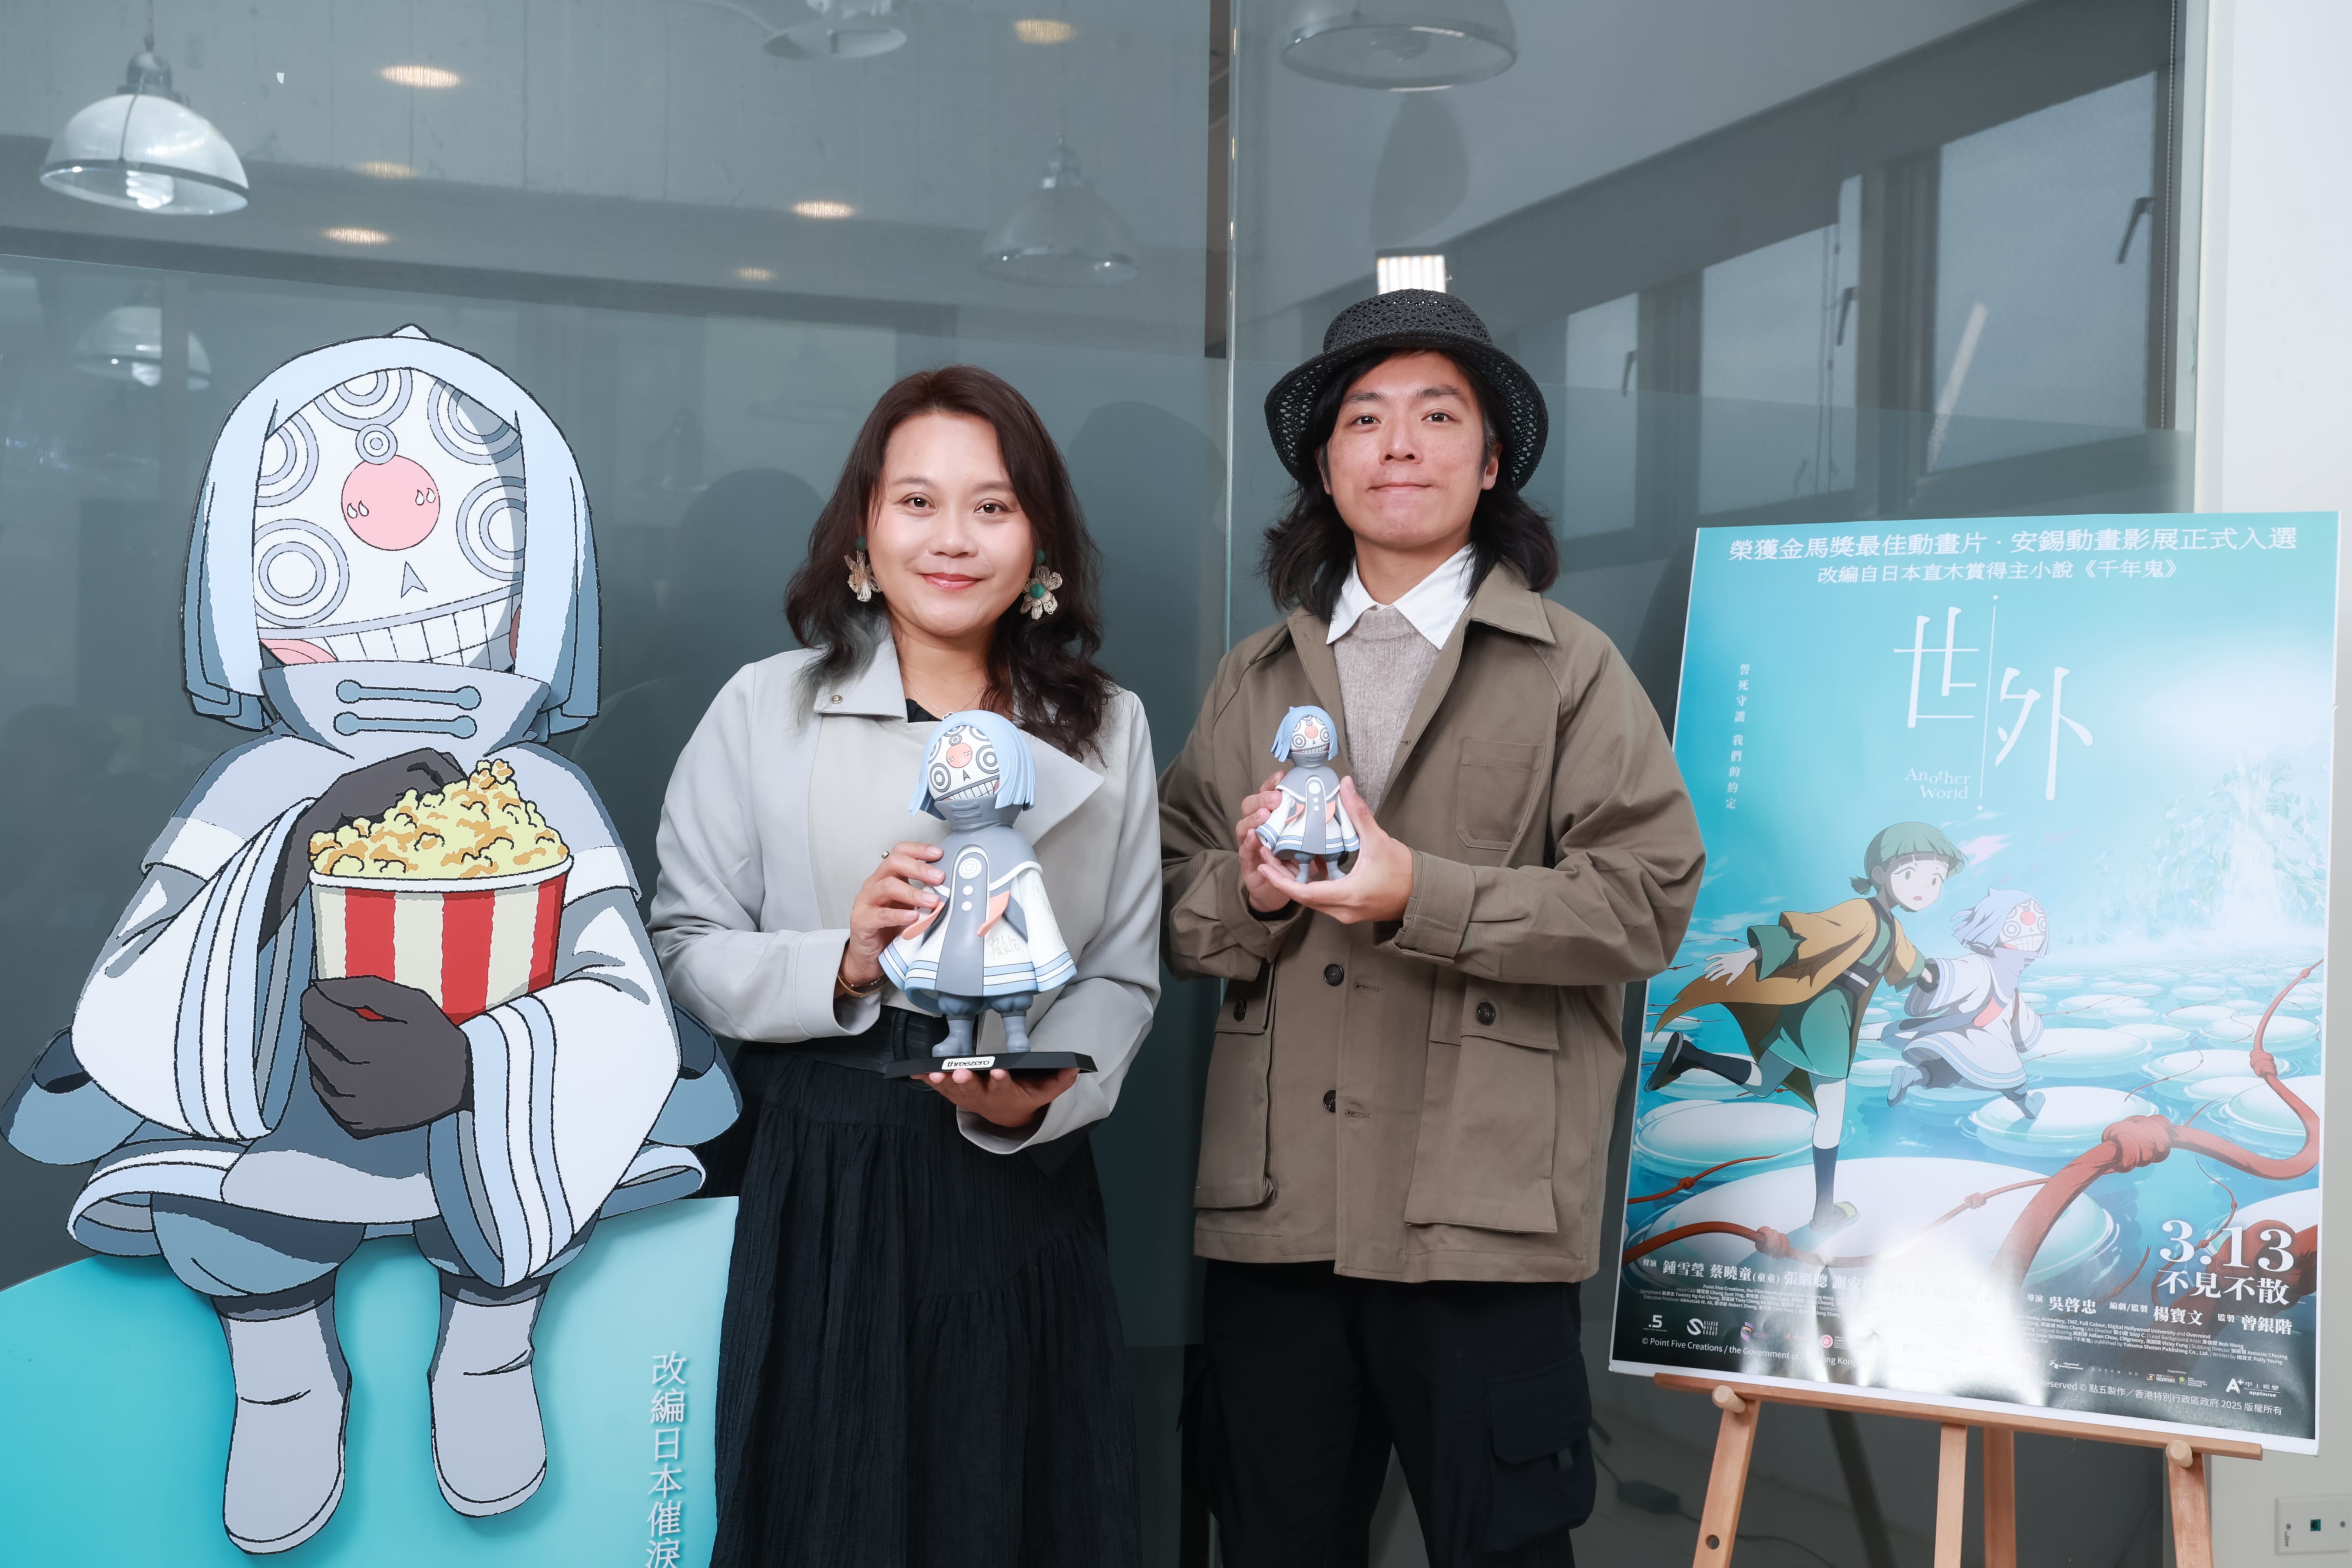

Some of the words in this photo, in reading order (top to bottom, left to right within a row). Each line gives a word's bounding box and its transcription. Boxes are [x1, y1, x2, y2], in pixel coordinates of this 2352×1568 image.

[1817, 559, 2177, 583] 改編自日本直木賞得主小說《千年鬼》
[1725, 734, 1743, 809] 我們的約定
[1904, 767, 1971, 784] Another
[1919, 785, 1968, 799] World
[2160, 1220, 2294, 1272] 3.13
[1662, 1260, 1705, 1278] 鍾雪瑩
[2027, 1293, 2043, 1303] 導演
[2153, 1305, 2203, 1326] 楊寶文
[2242, 1315, 2292, 1335] 曾銀階
[2156, 1270, 2290, 1305] 不見不散
[2120, 1336, 2145, 1344] CMgroovy,
[2162, 1346, 2188, 1355] Publishing
[1651, 1338, 1669, 1346] Point
[1671, 1340, 1686, 1348] Five
[1687, 1341, 1723, 1353] Creations
[1729, 1346, 1741, 1354] the
[1743, 1347, 1790, 1359] Government
[1838, 1357, 1859, 1367] Kong
[2040, 1379, 2077, 1390] Reserved
[2221, 1400, 2242, 1410] 2025
[2244, 1402, 2283, 1416] 版權所有
[645, 1350, 687, 1568] 改編日本催淚
